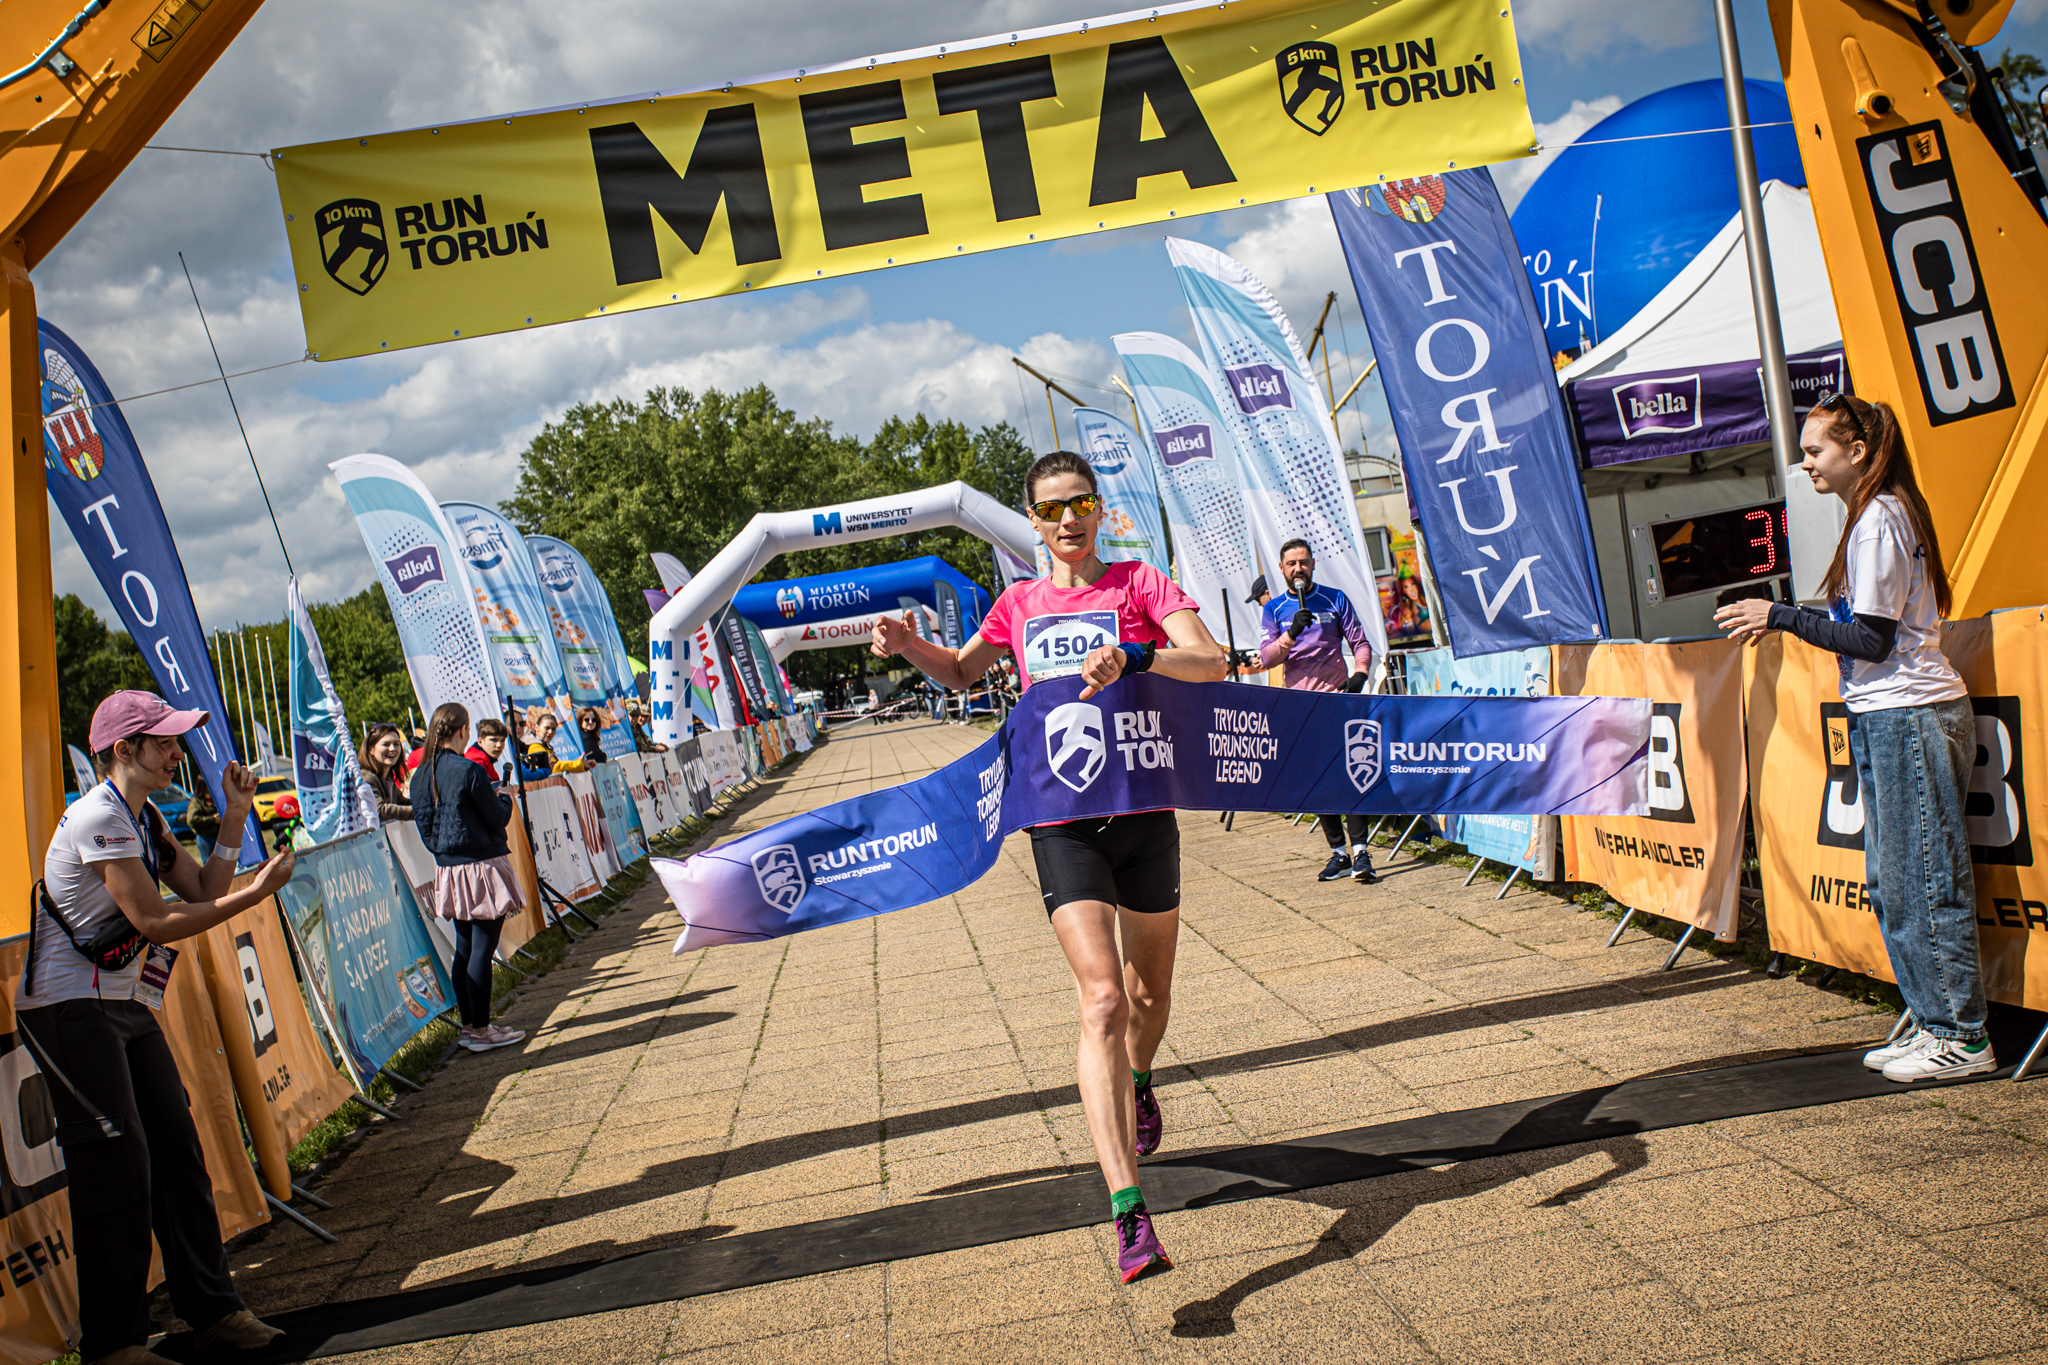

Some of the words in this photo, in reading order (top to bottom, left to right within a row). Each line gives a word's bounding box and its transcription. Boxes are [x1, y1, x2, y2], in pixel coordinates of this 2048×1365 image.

[1286, 51, 1298, 66] 5
[1299, 48, 1326, 62] km
[1350, 37, 1437, 79] RUN
[1355, 54, 1496, 111] TORUŃ
[589, 35, 1237, 285] META
[1914, 134, 1931, 160] JCB
[324, 207, 341, 225] 10
[342, 204, 372, 221] km
[395, 194, 487, 237] RUN
[401, 212, 549, 270] TORUŃ
[1869, 139, 2001, 414] JCB
[1629, 392, 1688, 420] bella
[845, 507, 913, 523] UNIWERSYTET
[847, 523, 869, 533] WSB
[870, 518, 908, 529] MERITO
[808, 585, 870, 611] TORUŃ
[810, 582, 856, 596] MIASTO
[1037, 633, 1106, 659] 1504
[1055, 657, 1087, 666] SVIATLAN
[1214, 708, 1270, 735] TRYLOGIA
[1390, 742, 1547, 762] RUNTORUN
[1829, 726, 1846, 756] JCB
[1215, 759, 1262, 784] LEGEND
[1390, 764, 1471, 775] Stowarzyszenie
[1826, 715, 2021, 848] JB
[807, 822, 938, 874] RUNTORUN
[813, 861, 892, 887] Stowarzyszenie
